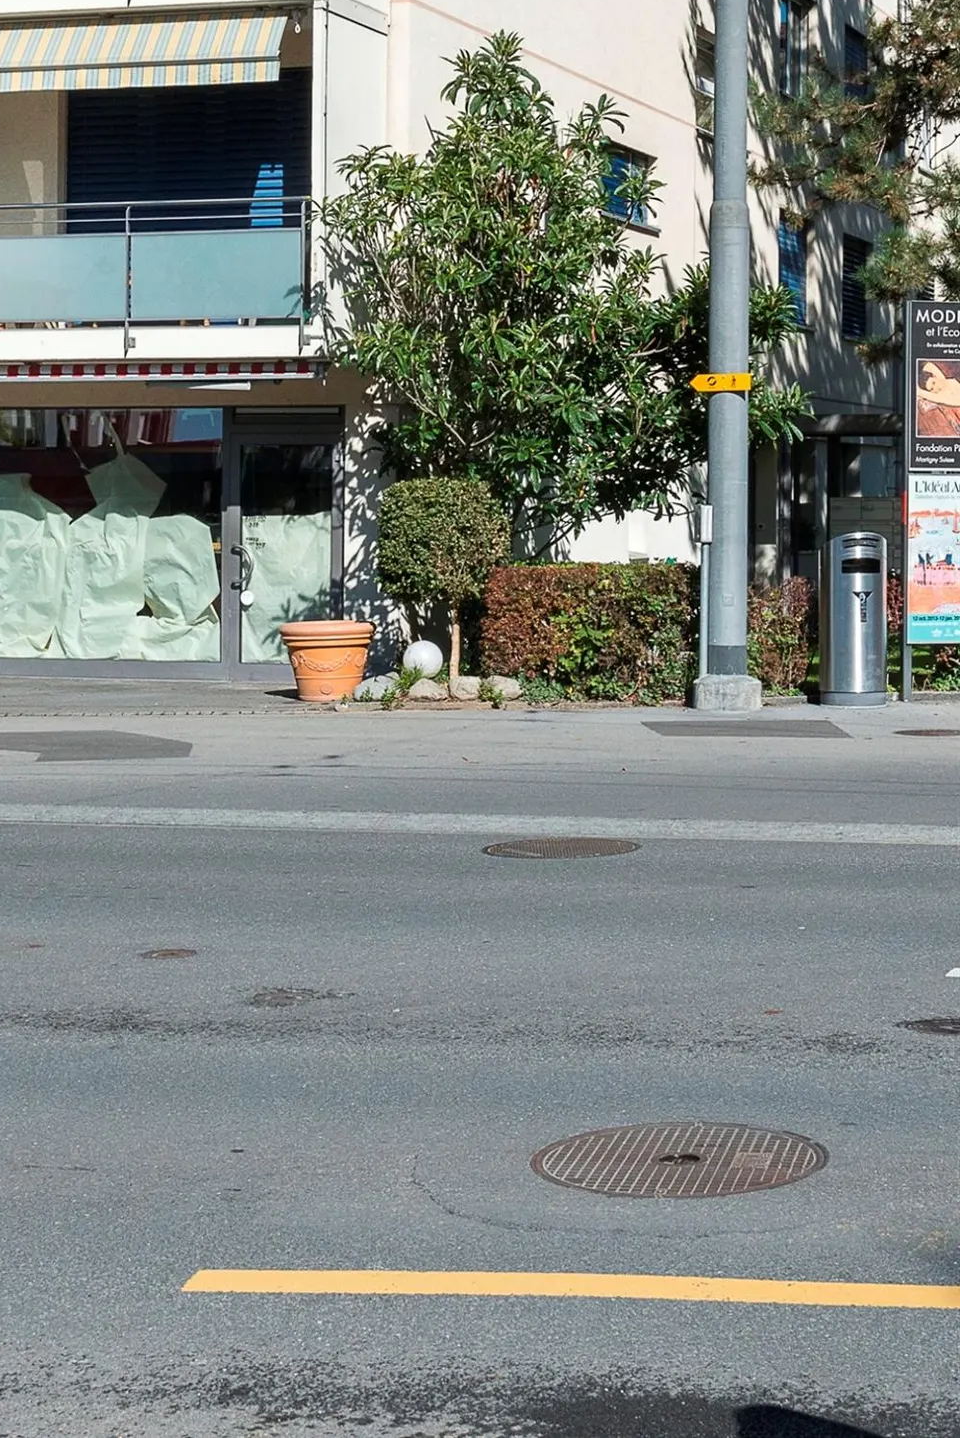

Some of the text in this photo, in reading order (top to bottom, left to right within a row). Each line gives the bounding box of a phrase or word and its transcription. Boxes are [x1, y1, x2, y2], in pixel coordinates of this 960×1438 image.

[926, 328, 935, 337] et
[916, 443, 953, 452] Fondation
[915, 456, 939, 464] Martigny
